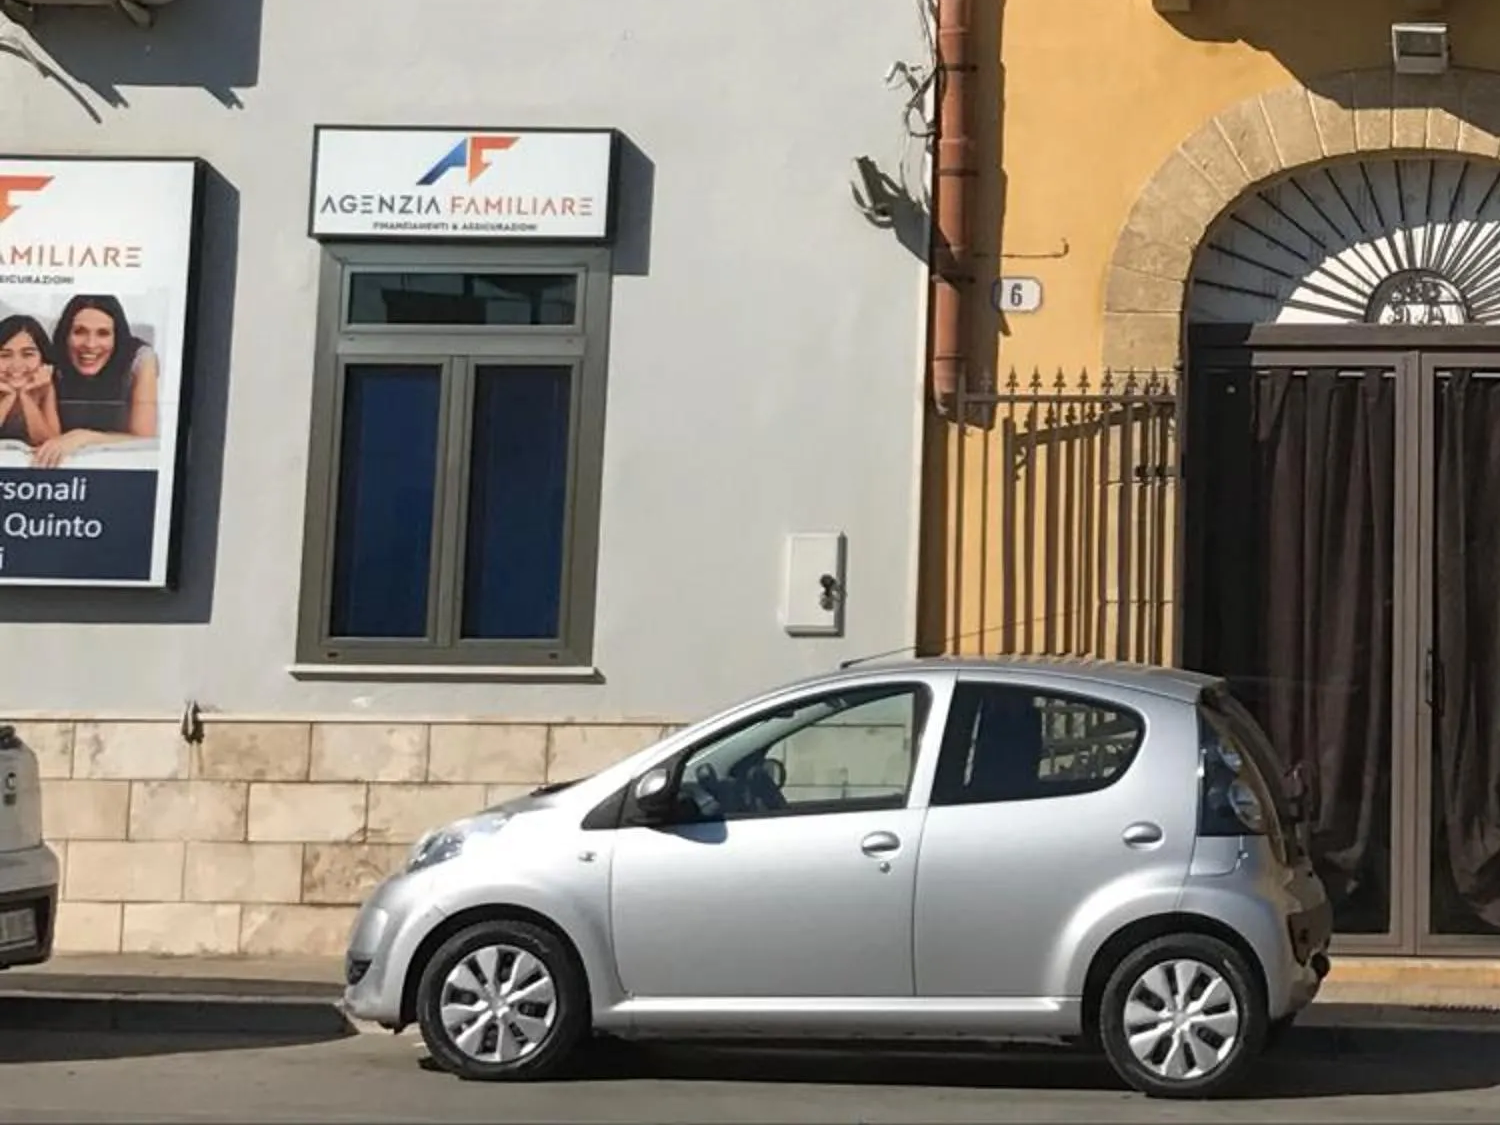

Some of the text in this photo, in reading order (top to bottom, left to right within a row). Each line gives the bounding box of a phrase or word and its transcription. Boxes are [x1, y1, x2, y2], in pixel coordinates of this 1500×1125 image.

[320, 194, 593, 216] AGENZIA FAMILIARE
[1010, 282, 1024, 307] 6
[4, 512, 102, 539] Quinto
